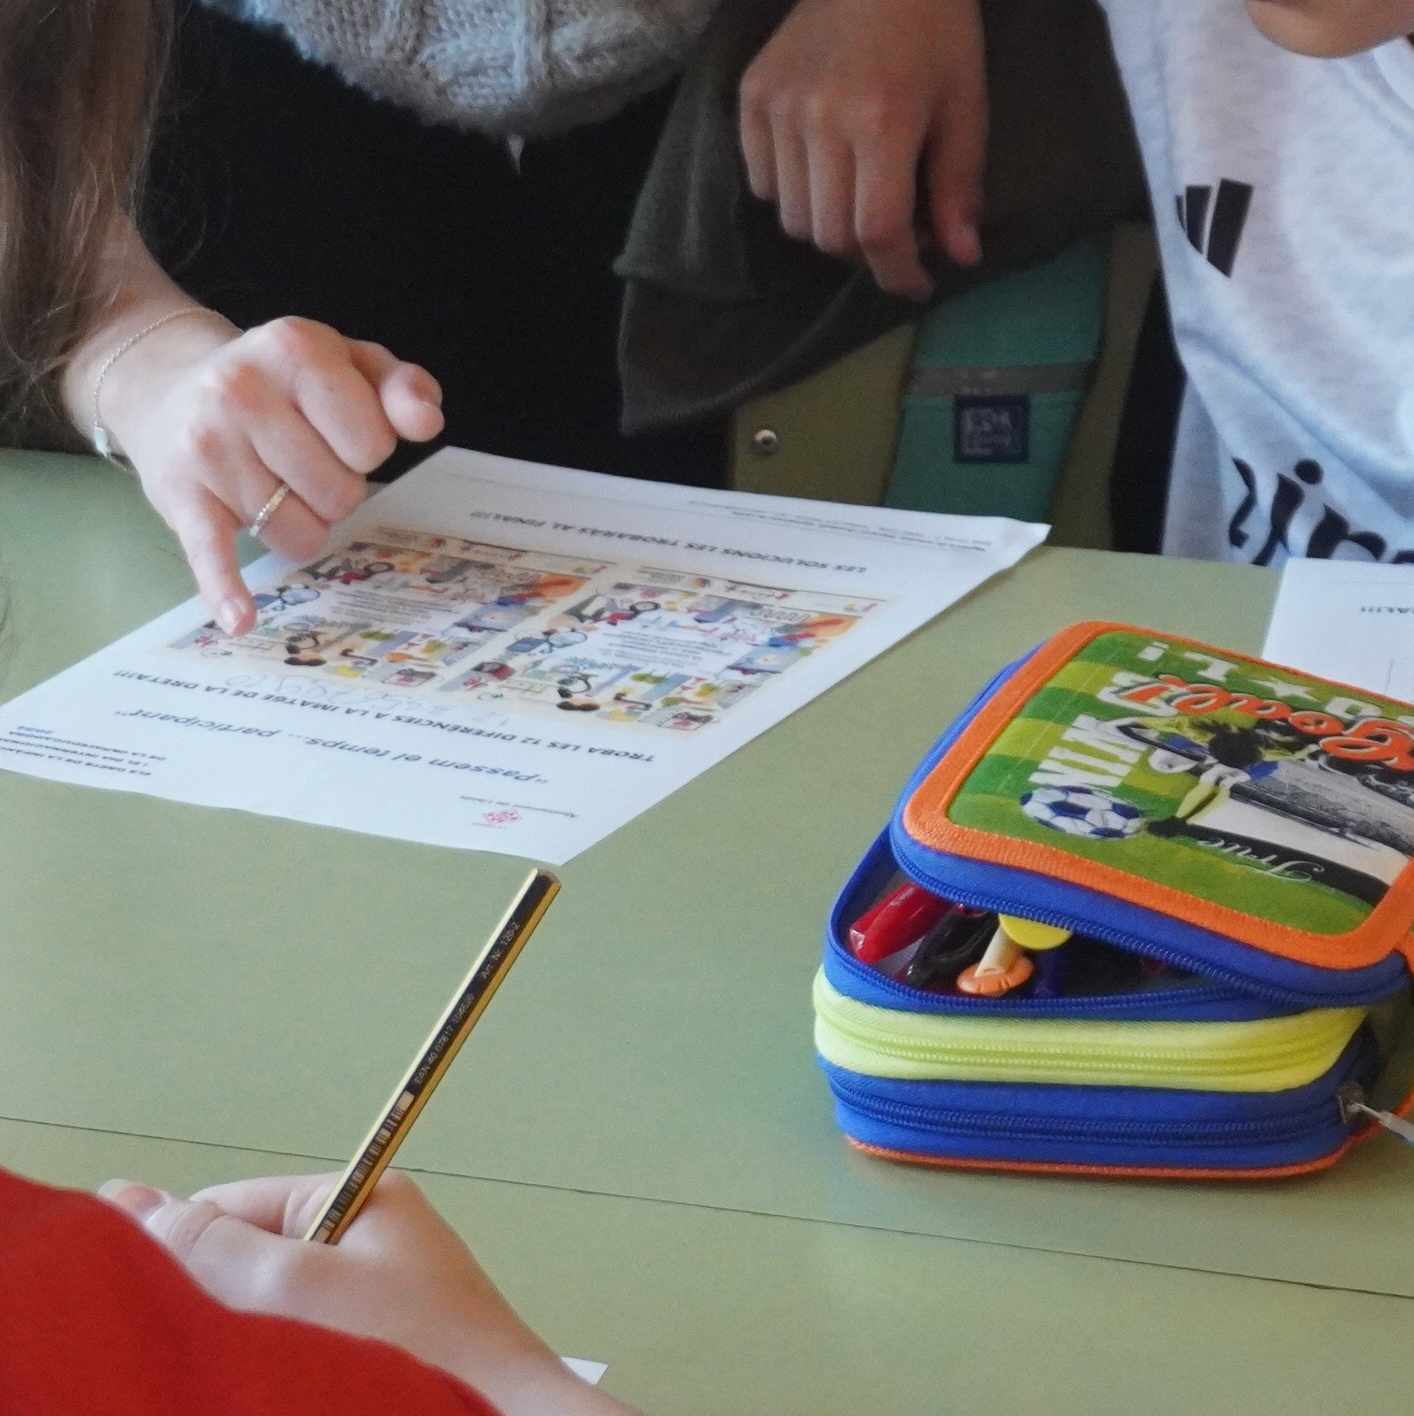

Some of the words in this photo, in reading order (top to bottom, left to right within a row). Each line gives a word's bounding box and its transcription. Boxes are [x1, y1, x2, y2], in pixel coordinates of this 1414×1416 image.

[113, 671, 200, 690] DRETA!!!
[204, 685, 229, 695] LA
[232, 689, 259, 699] DE
[262, 694, 340, 712] IMATGE
[344, 707, 369, 717] LA
[374, 712, 389, 720] A
[393, 715, 517, 742] DIFERÈNCIES
[520, 737, 542, 746] 12
[547, 741, 582, 752] LES
[391, 753, 422, 762] el
[587, 746, 654, 763] TROBA
[1193, 837, 1325, 882] True
